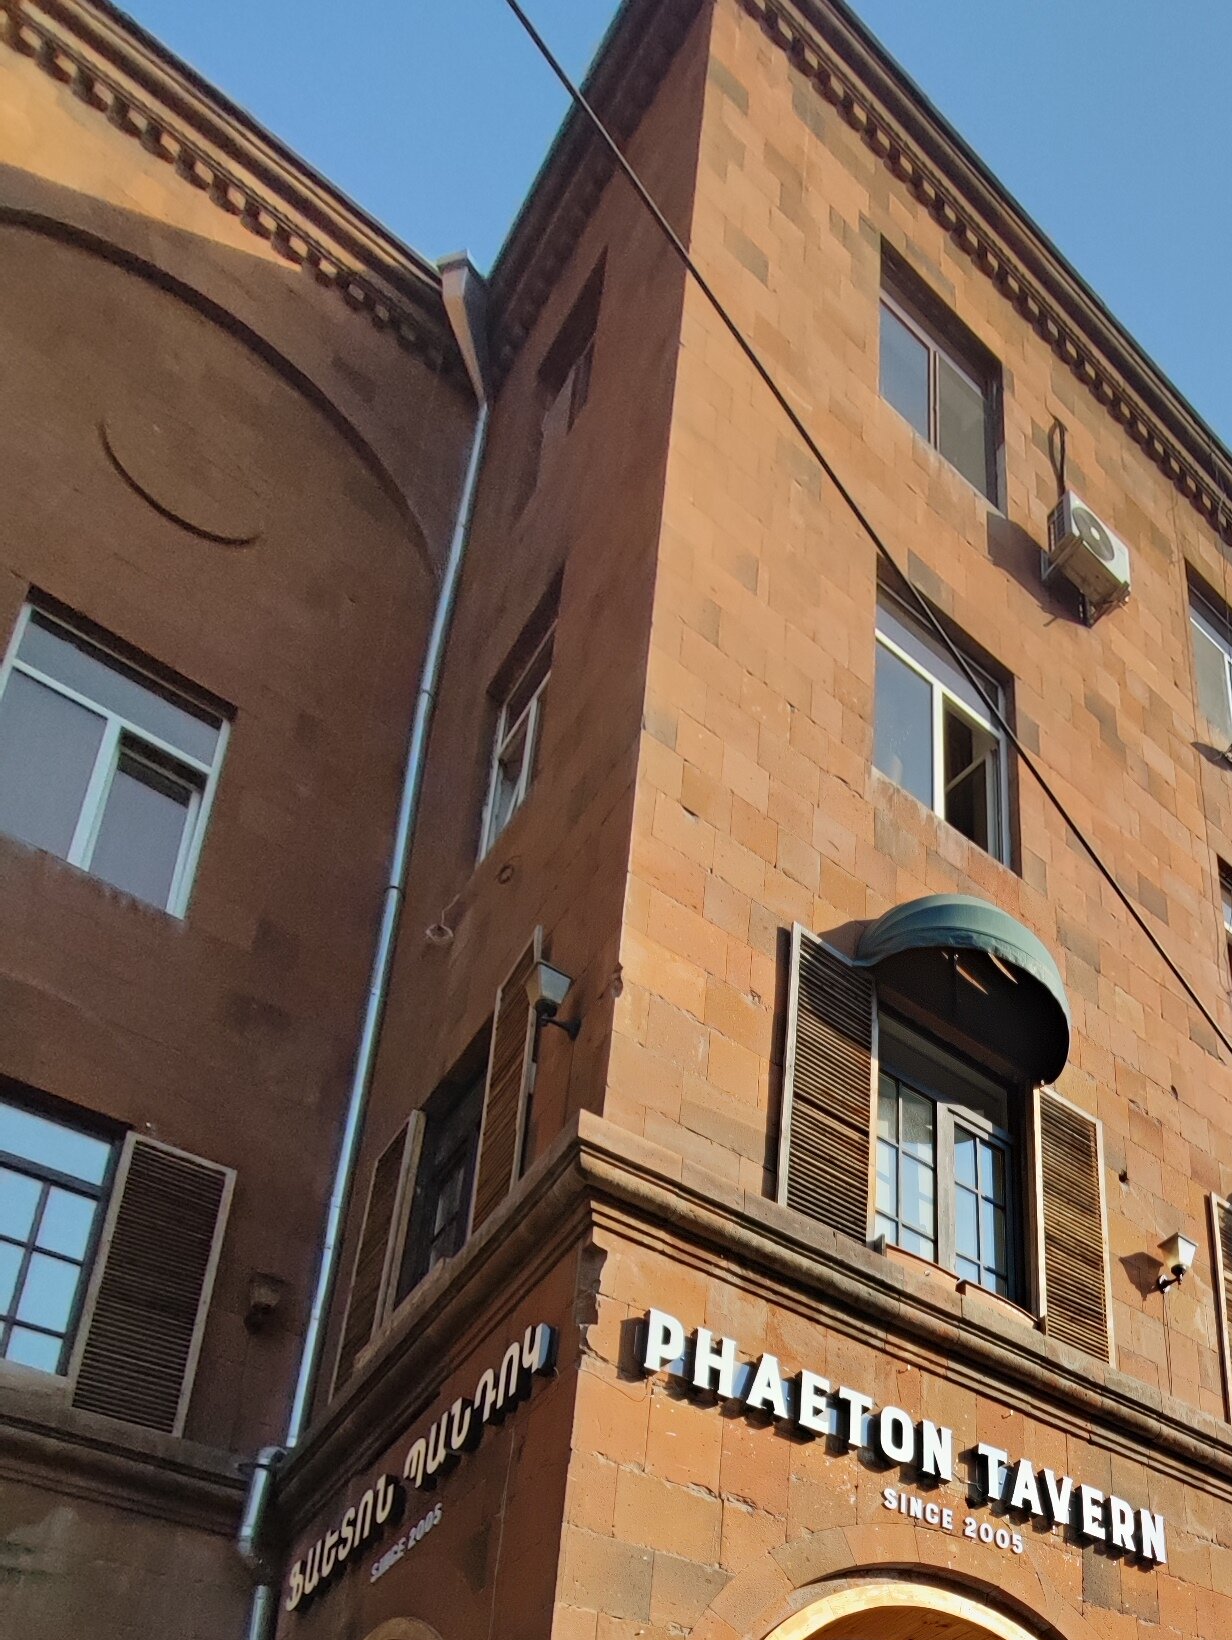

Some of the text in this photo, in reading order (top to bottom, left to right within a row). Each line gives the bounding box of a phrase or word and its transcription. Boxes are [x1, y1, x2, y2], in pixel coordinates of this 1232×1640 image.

[402, 1322, 550, 1489] ՊԱՆԴՈԿ
[643, 1308, 1168, 1565] PHAETON TAVERN
[407, 1502, 444, 1550] 2005
[883, 1487, 1024, 1555] SINCE 2005
